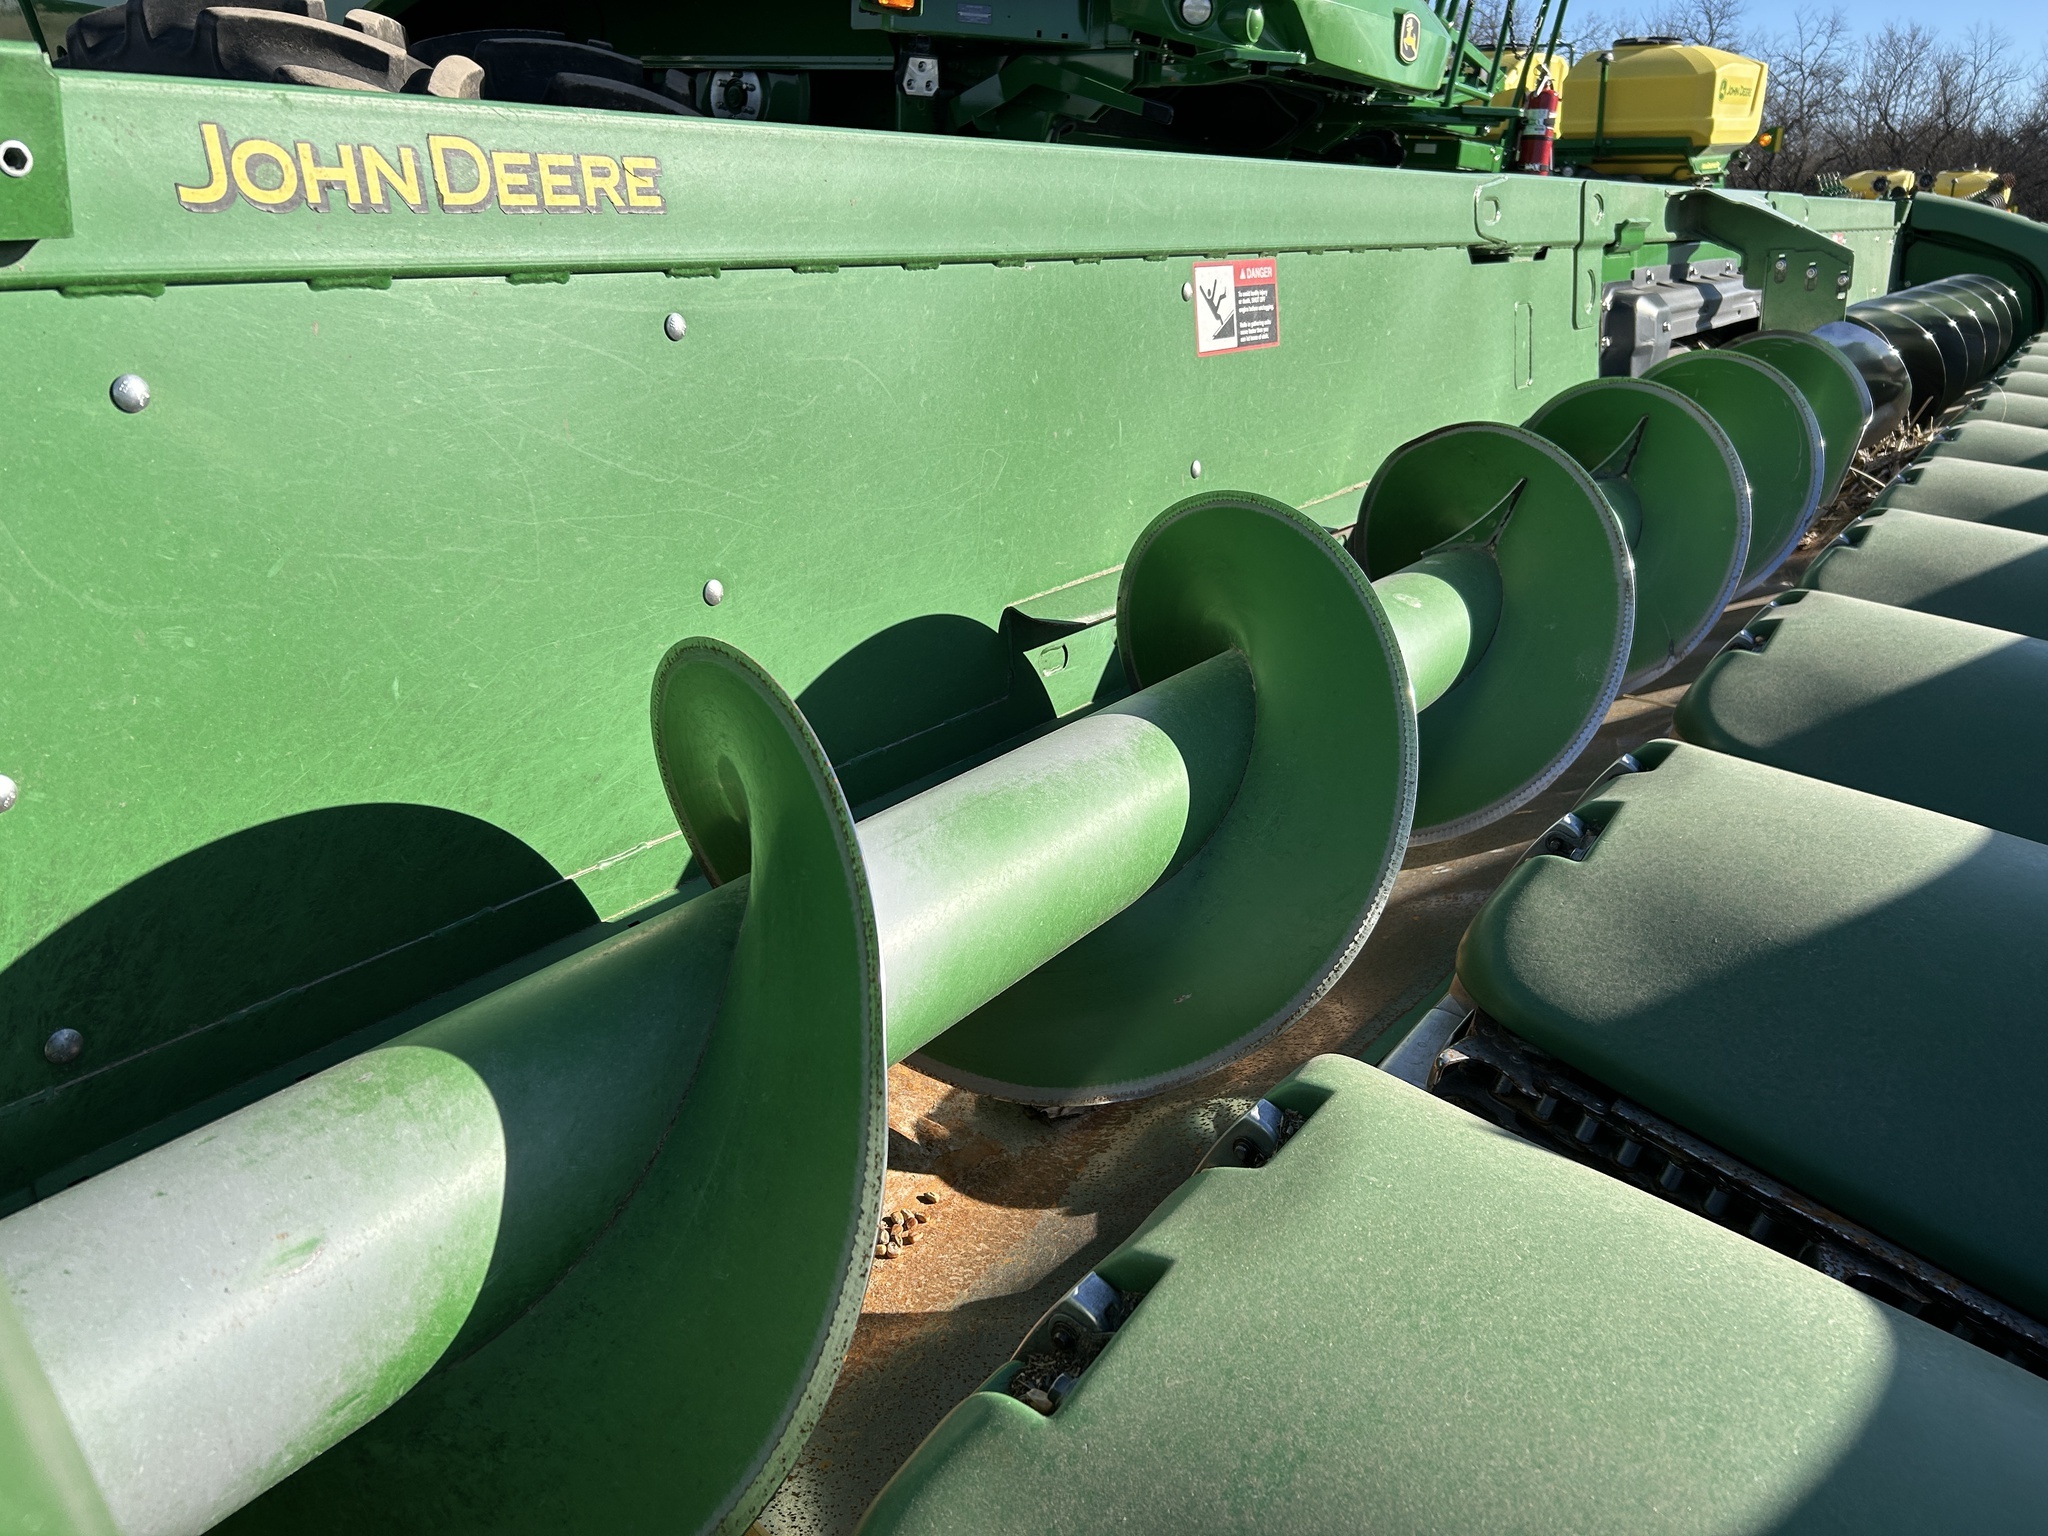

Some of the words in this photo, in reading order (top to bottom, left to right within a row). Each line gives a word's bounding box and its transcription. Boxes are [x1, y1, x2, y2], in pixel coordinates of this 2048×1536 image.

[176, 122, 428, 212] JOHN
[428, 134, 665, 213] DEERE
[1246, 266, 1273, 279] DANGER
